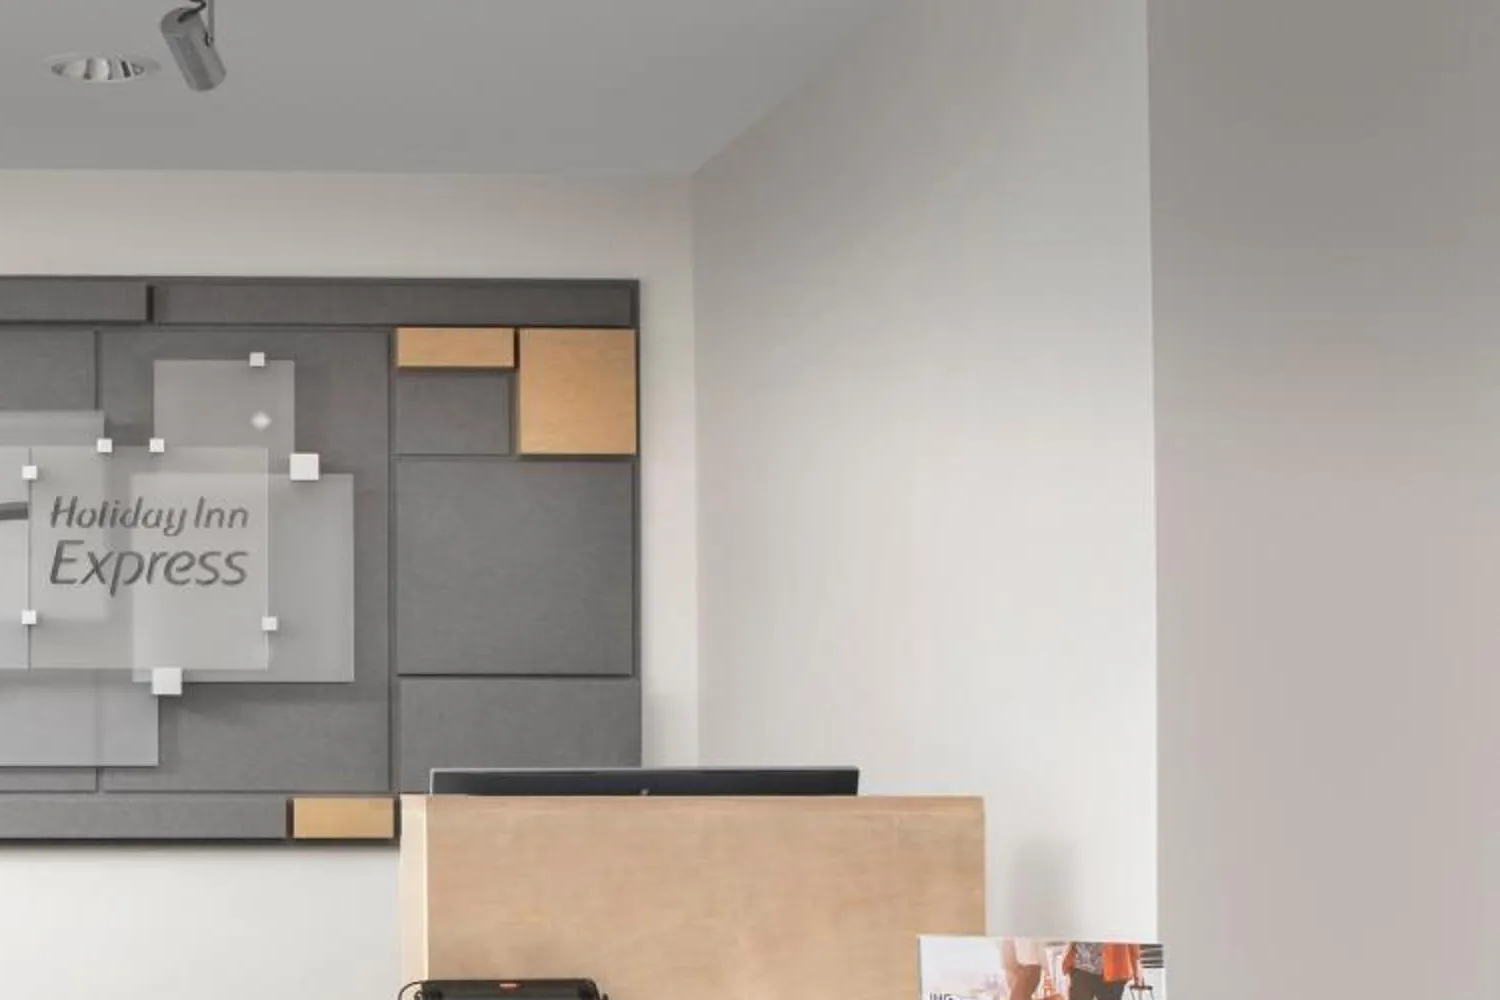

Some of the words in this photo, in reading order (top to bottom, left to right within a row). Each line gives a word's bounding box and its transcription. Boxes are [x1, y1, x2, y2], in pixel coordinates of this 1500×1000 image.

[50, 495, 188, 537] Holiday
[193, 495, 250, 529] Inn
[50, 538, 249, 598] Express
